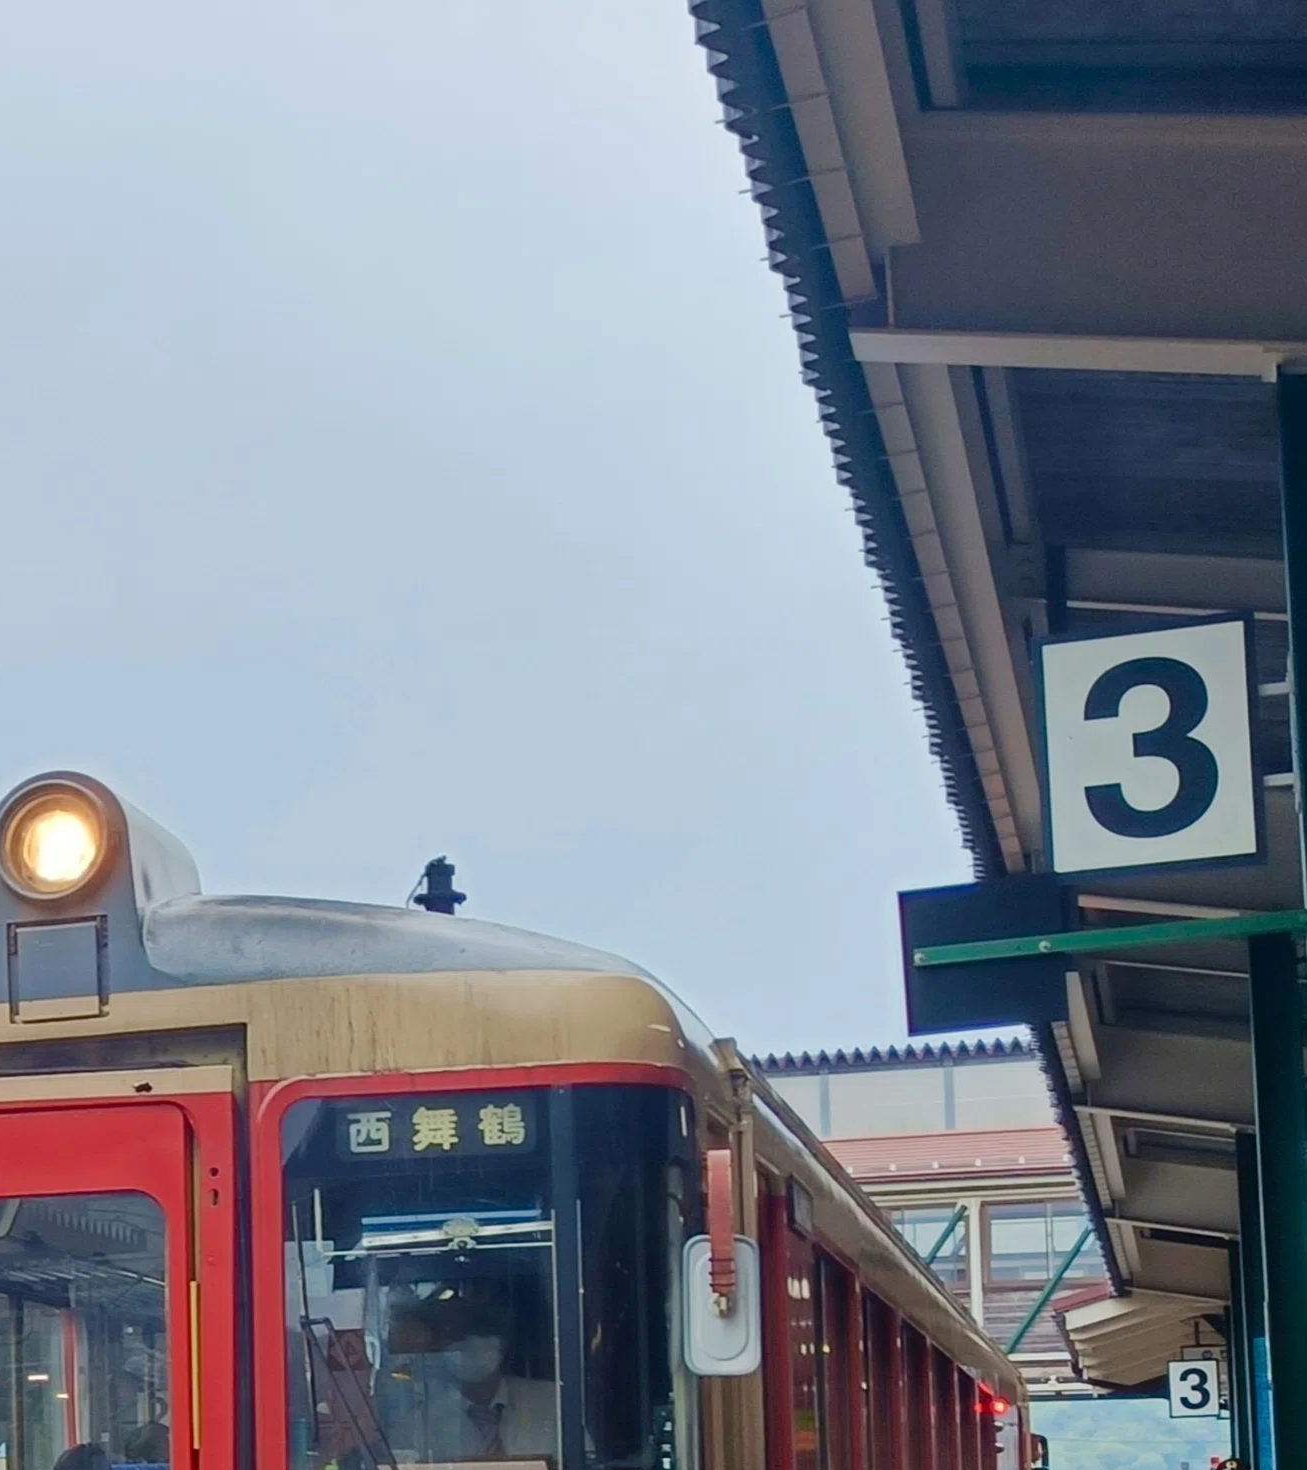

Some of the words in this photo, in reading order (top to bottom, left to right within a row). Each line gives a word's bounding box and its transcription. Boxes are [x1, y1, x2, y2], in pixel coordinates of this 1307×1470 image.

[1084, 657, 1219, 838] 3
[347, 1103, 526, 1153] 西舞鶴
[1179, 1367, 1211, 1410] 3
